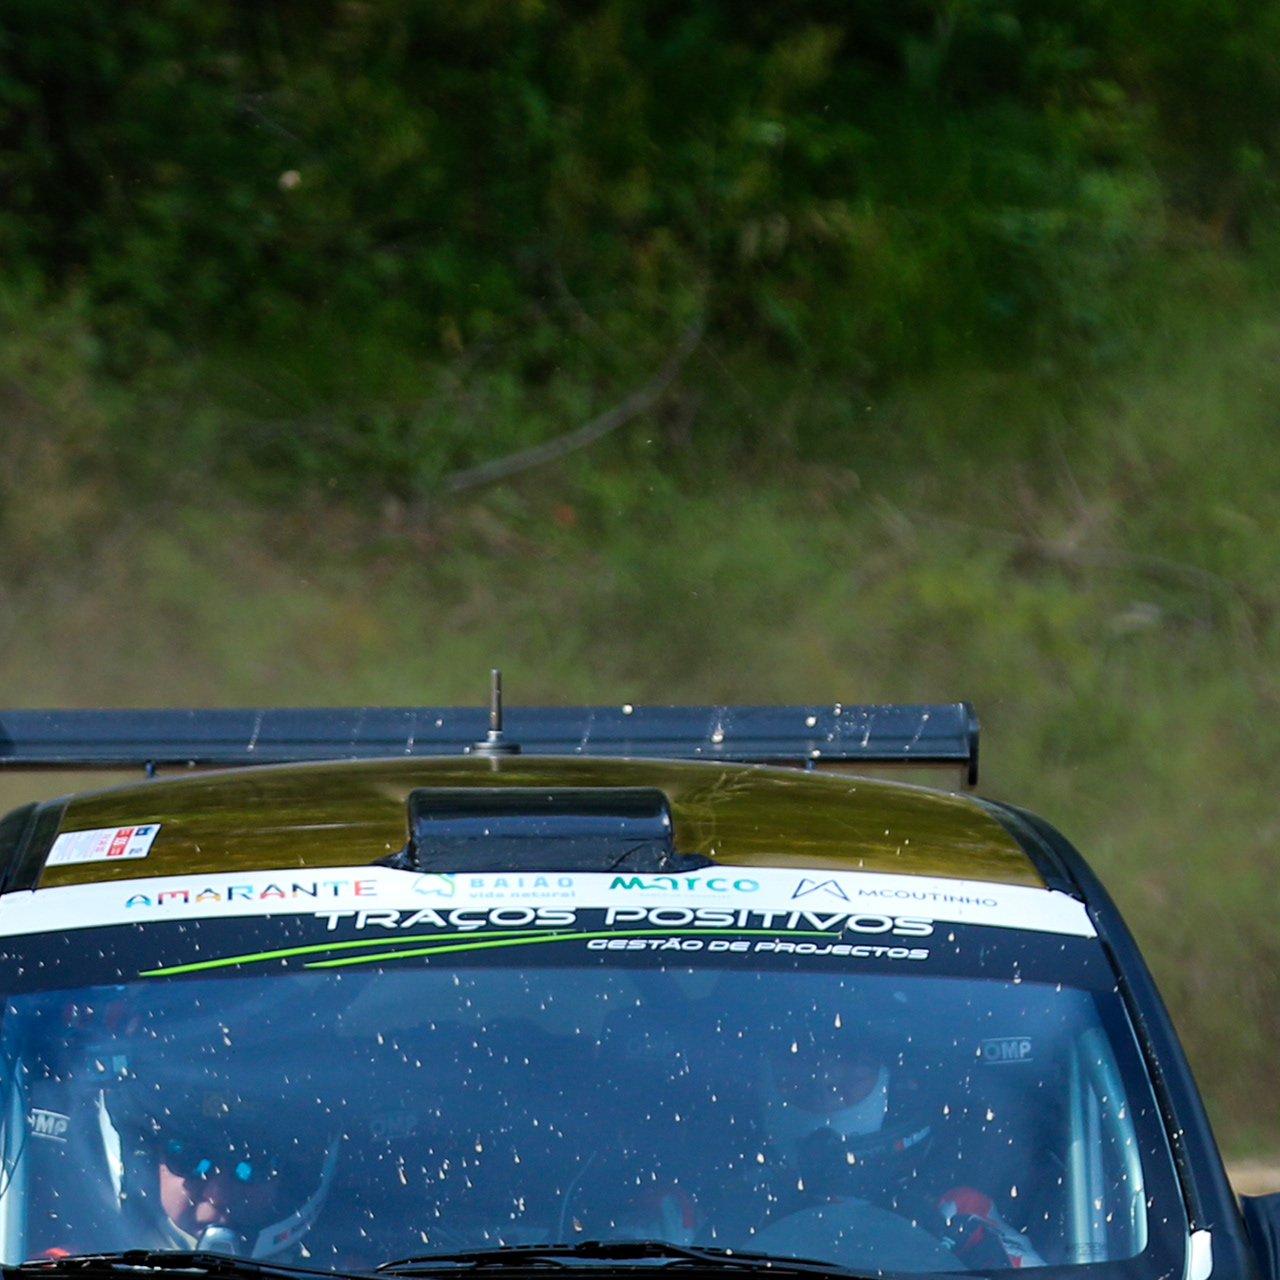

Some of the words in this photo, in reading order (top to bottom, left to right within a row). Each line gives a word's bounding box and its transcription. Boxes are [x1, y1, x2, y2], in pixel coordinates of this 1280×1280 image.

[125, 879, 379, 908] AMARANTE
[469, 890, 505, 899] vida
[510, 889, 577, 899] natural
[858, 889, 999, 908] MCOUTINHO
[314, 906, 577, 931] TRAÇOS
[605, 906, 934, 937] POSITIVOS
[587, 937, 704, 951] GESTÃO
[708, 940, 751, 952] DE
[754, 942, 930, 960] PROJECTOS
[983, 1040, 1032, 1060] OMP
